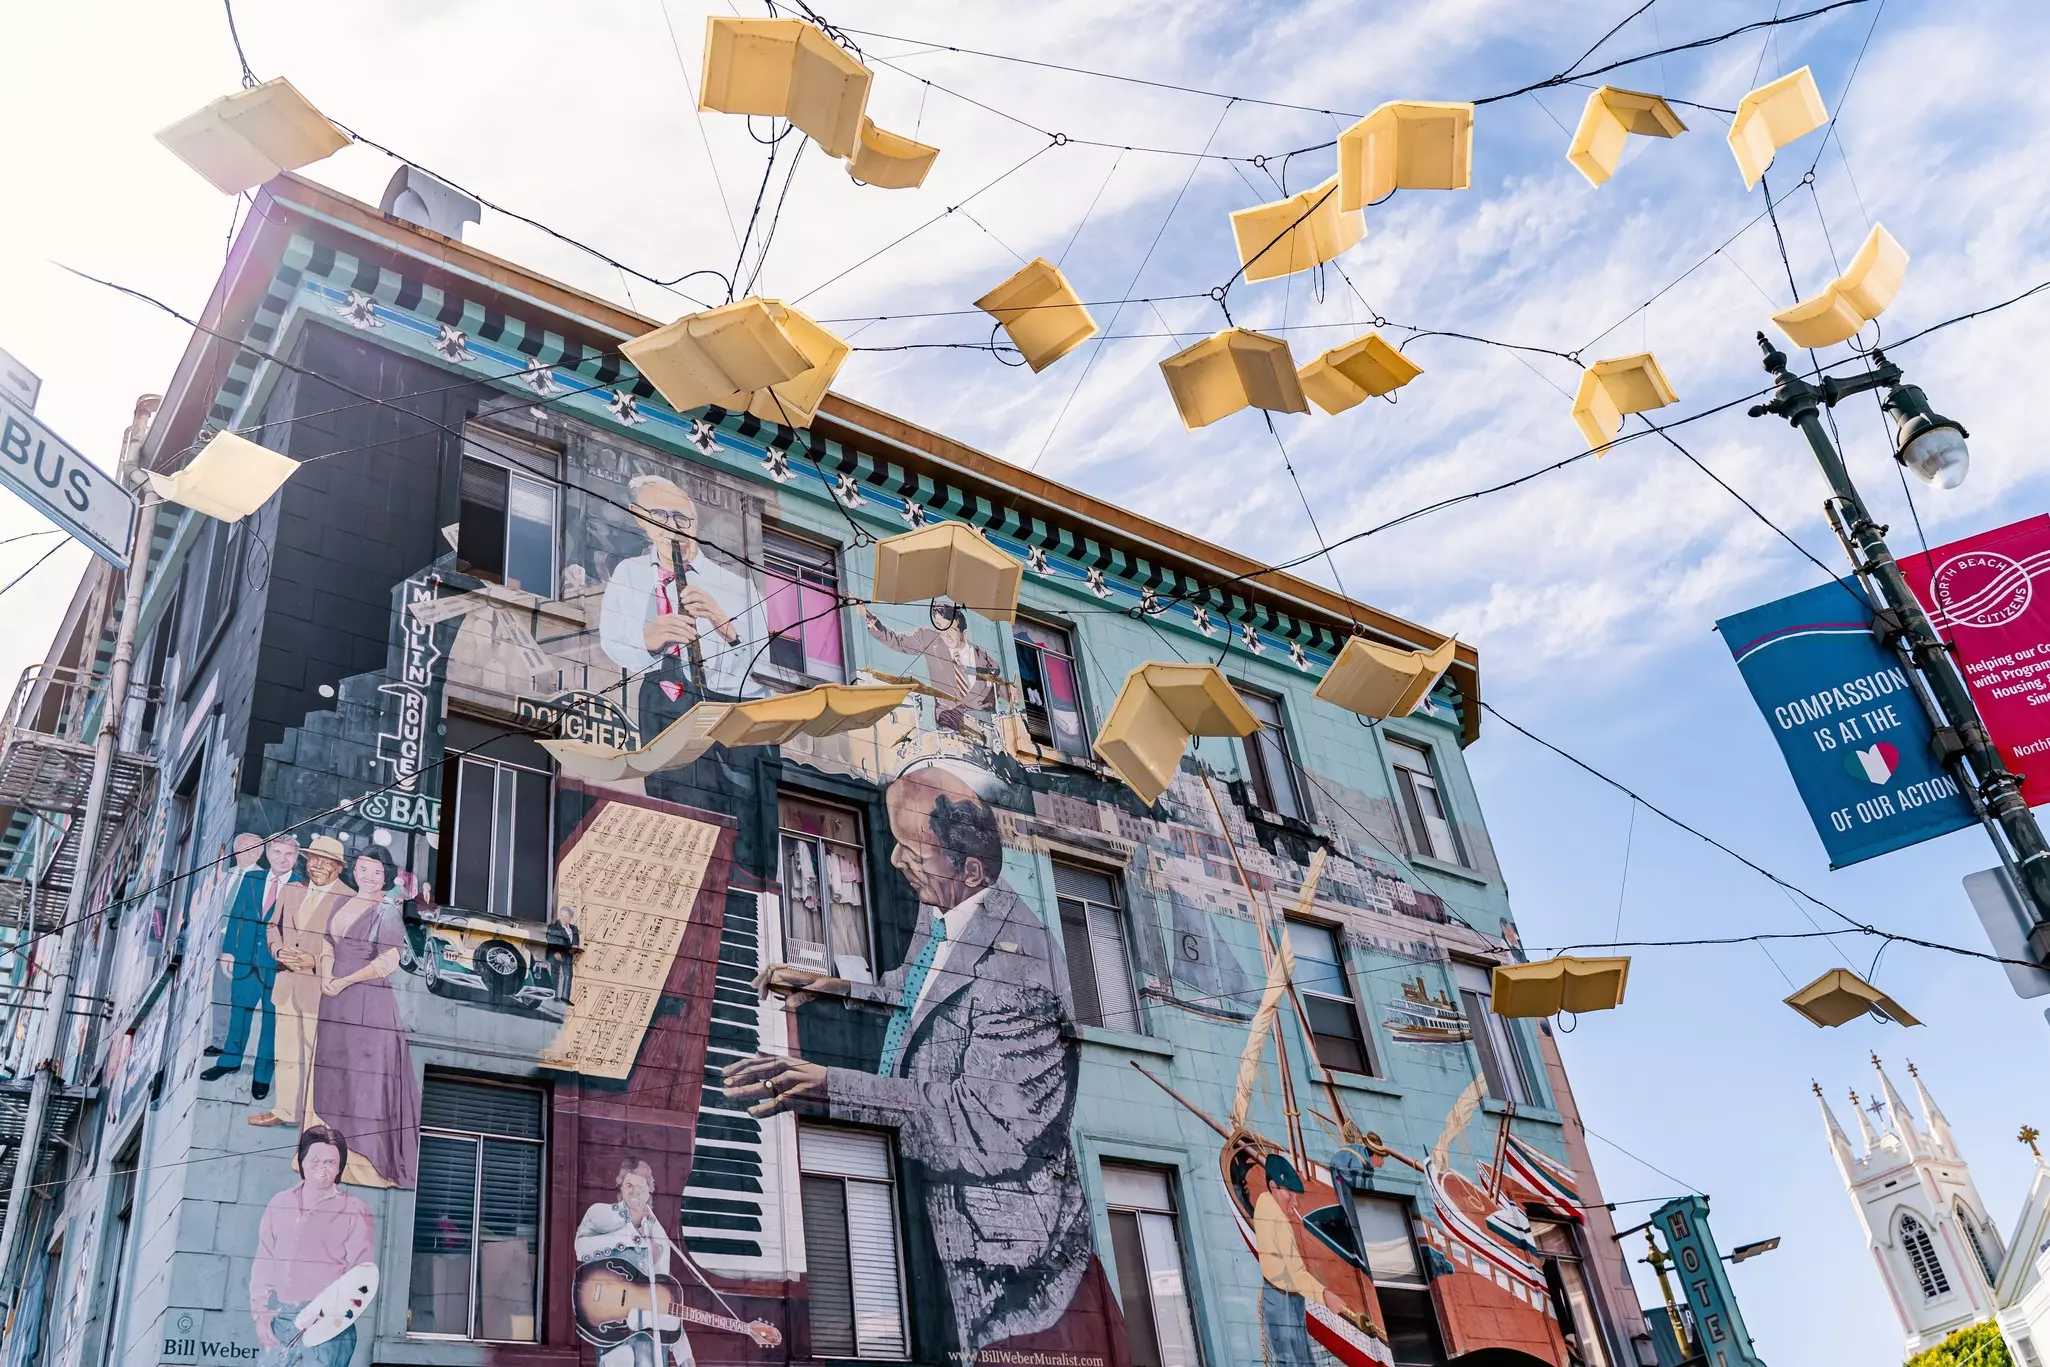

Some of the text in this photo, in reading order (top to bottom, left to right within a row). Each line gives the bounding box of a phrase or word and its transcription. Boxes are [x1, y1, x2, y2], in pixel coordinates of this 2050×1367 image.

[0, 415, 91, 511] BUS
[1938, 557, 2007, 605] NORTH BEACH
[1976, 587, 2027, 624] CITIZENS
[409, 587, 432, 683] MULIN
[1965, 656, 2015, 675] Helping
[2014, 648, 2035, 661] our
[1775, 666, 1909, 730] COMPASSION
[1973, 673, 2001, 688] with
[1991, 678, 2047, 700] Housing,
[573, 693, 613, 721] ELI
[400, 692, 421, 776] ROUGE
[1813, 704, 1902, 752] IS AT THE
[1830, 807, 1853, 832] OF
[1856, 795, 1896, 824] OUR
[163, 1339, 260, 1358] Bill Weber
[948, 1350, 1104, 1367] www.BillWeberMuralist.com
